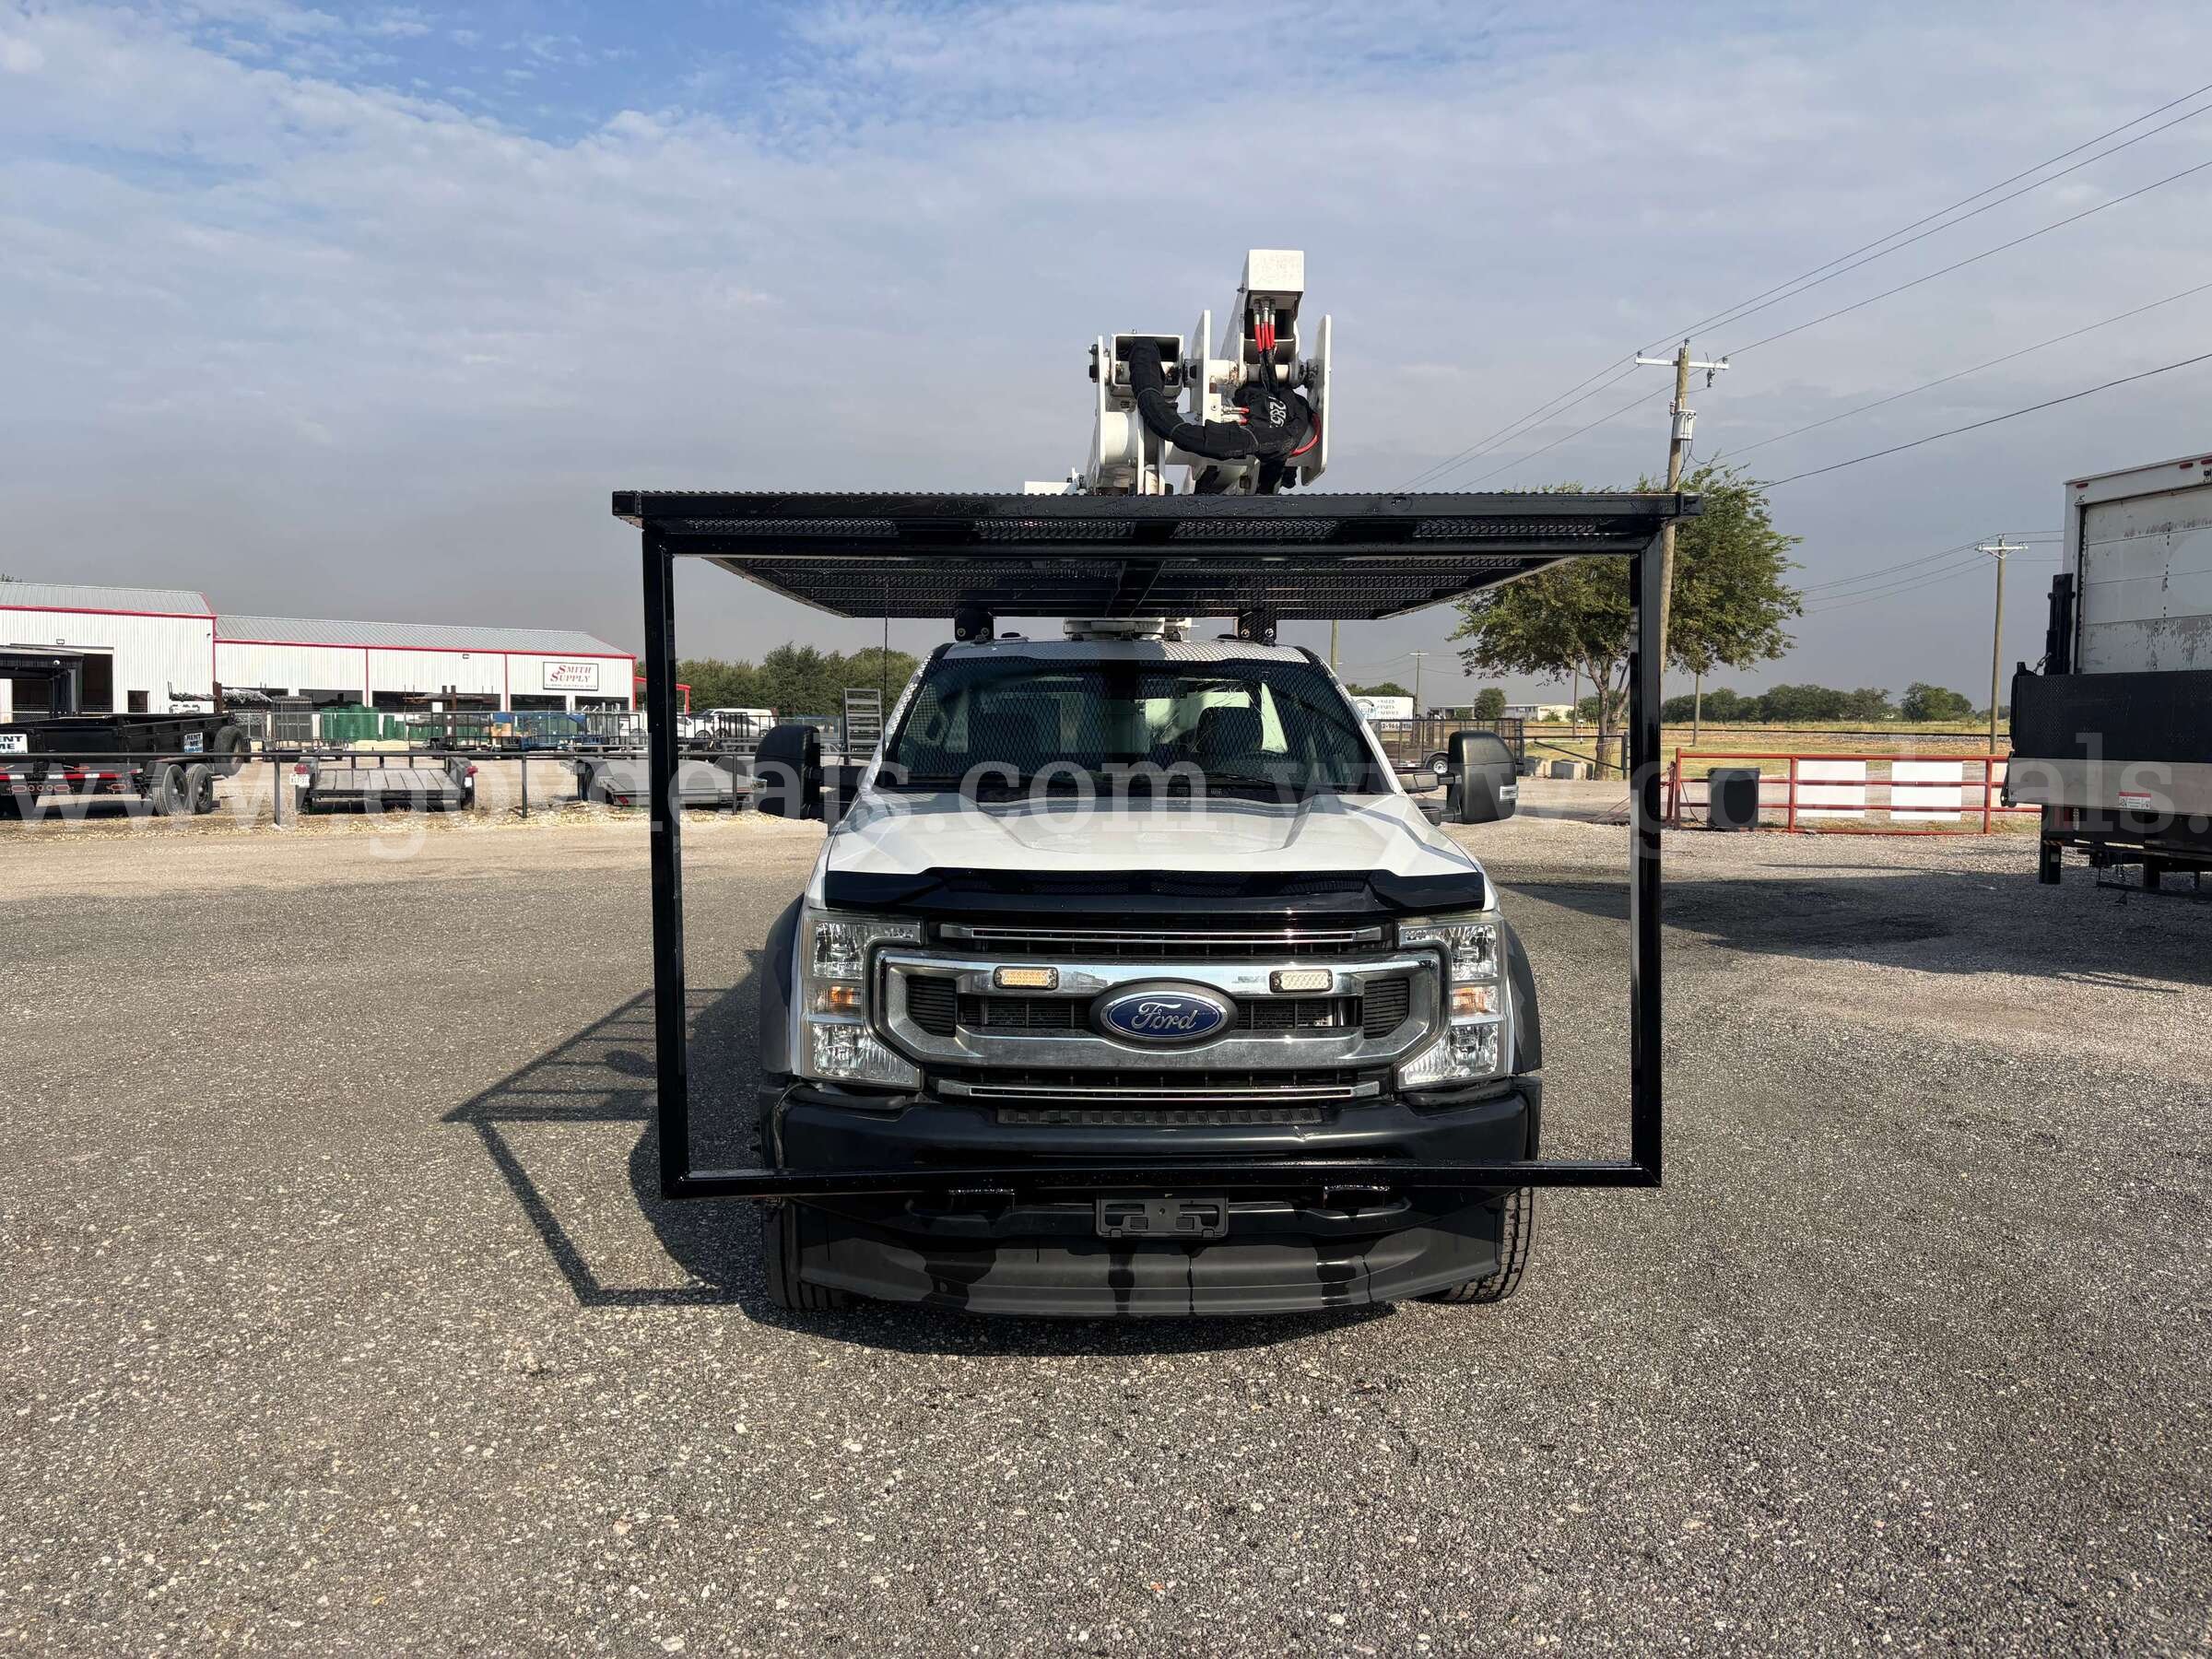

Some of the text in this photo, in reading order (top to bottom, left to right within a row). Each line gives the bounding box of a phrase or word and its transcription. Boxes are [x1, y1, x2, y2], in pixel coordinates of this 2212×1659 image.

[559, 665, 592, 674] SMITH
[550, 672, 591, 683] SUPPLY
[1131, 1002, 1197, 1030] Ford
